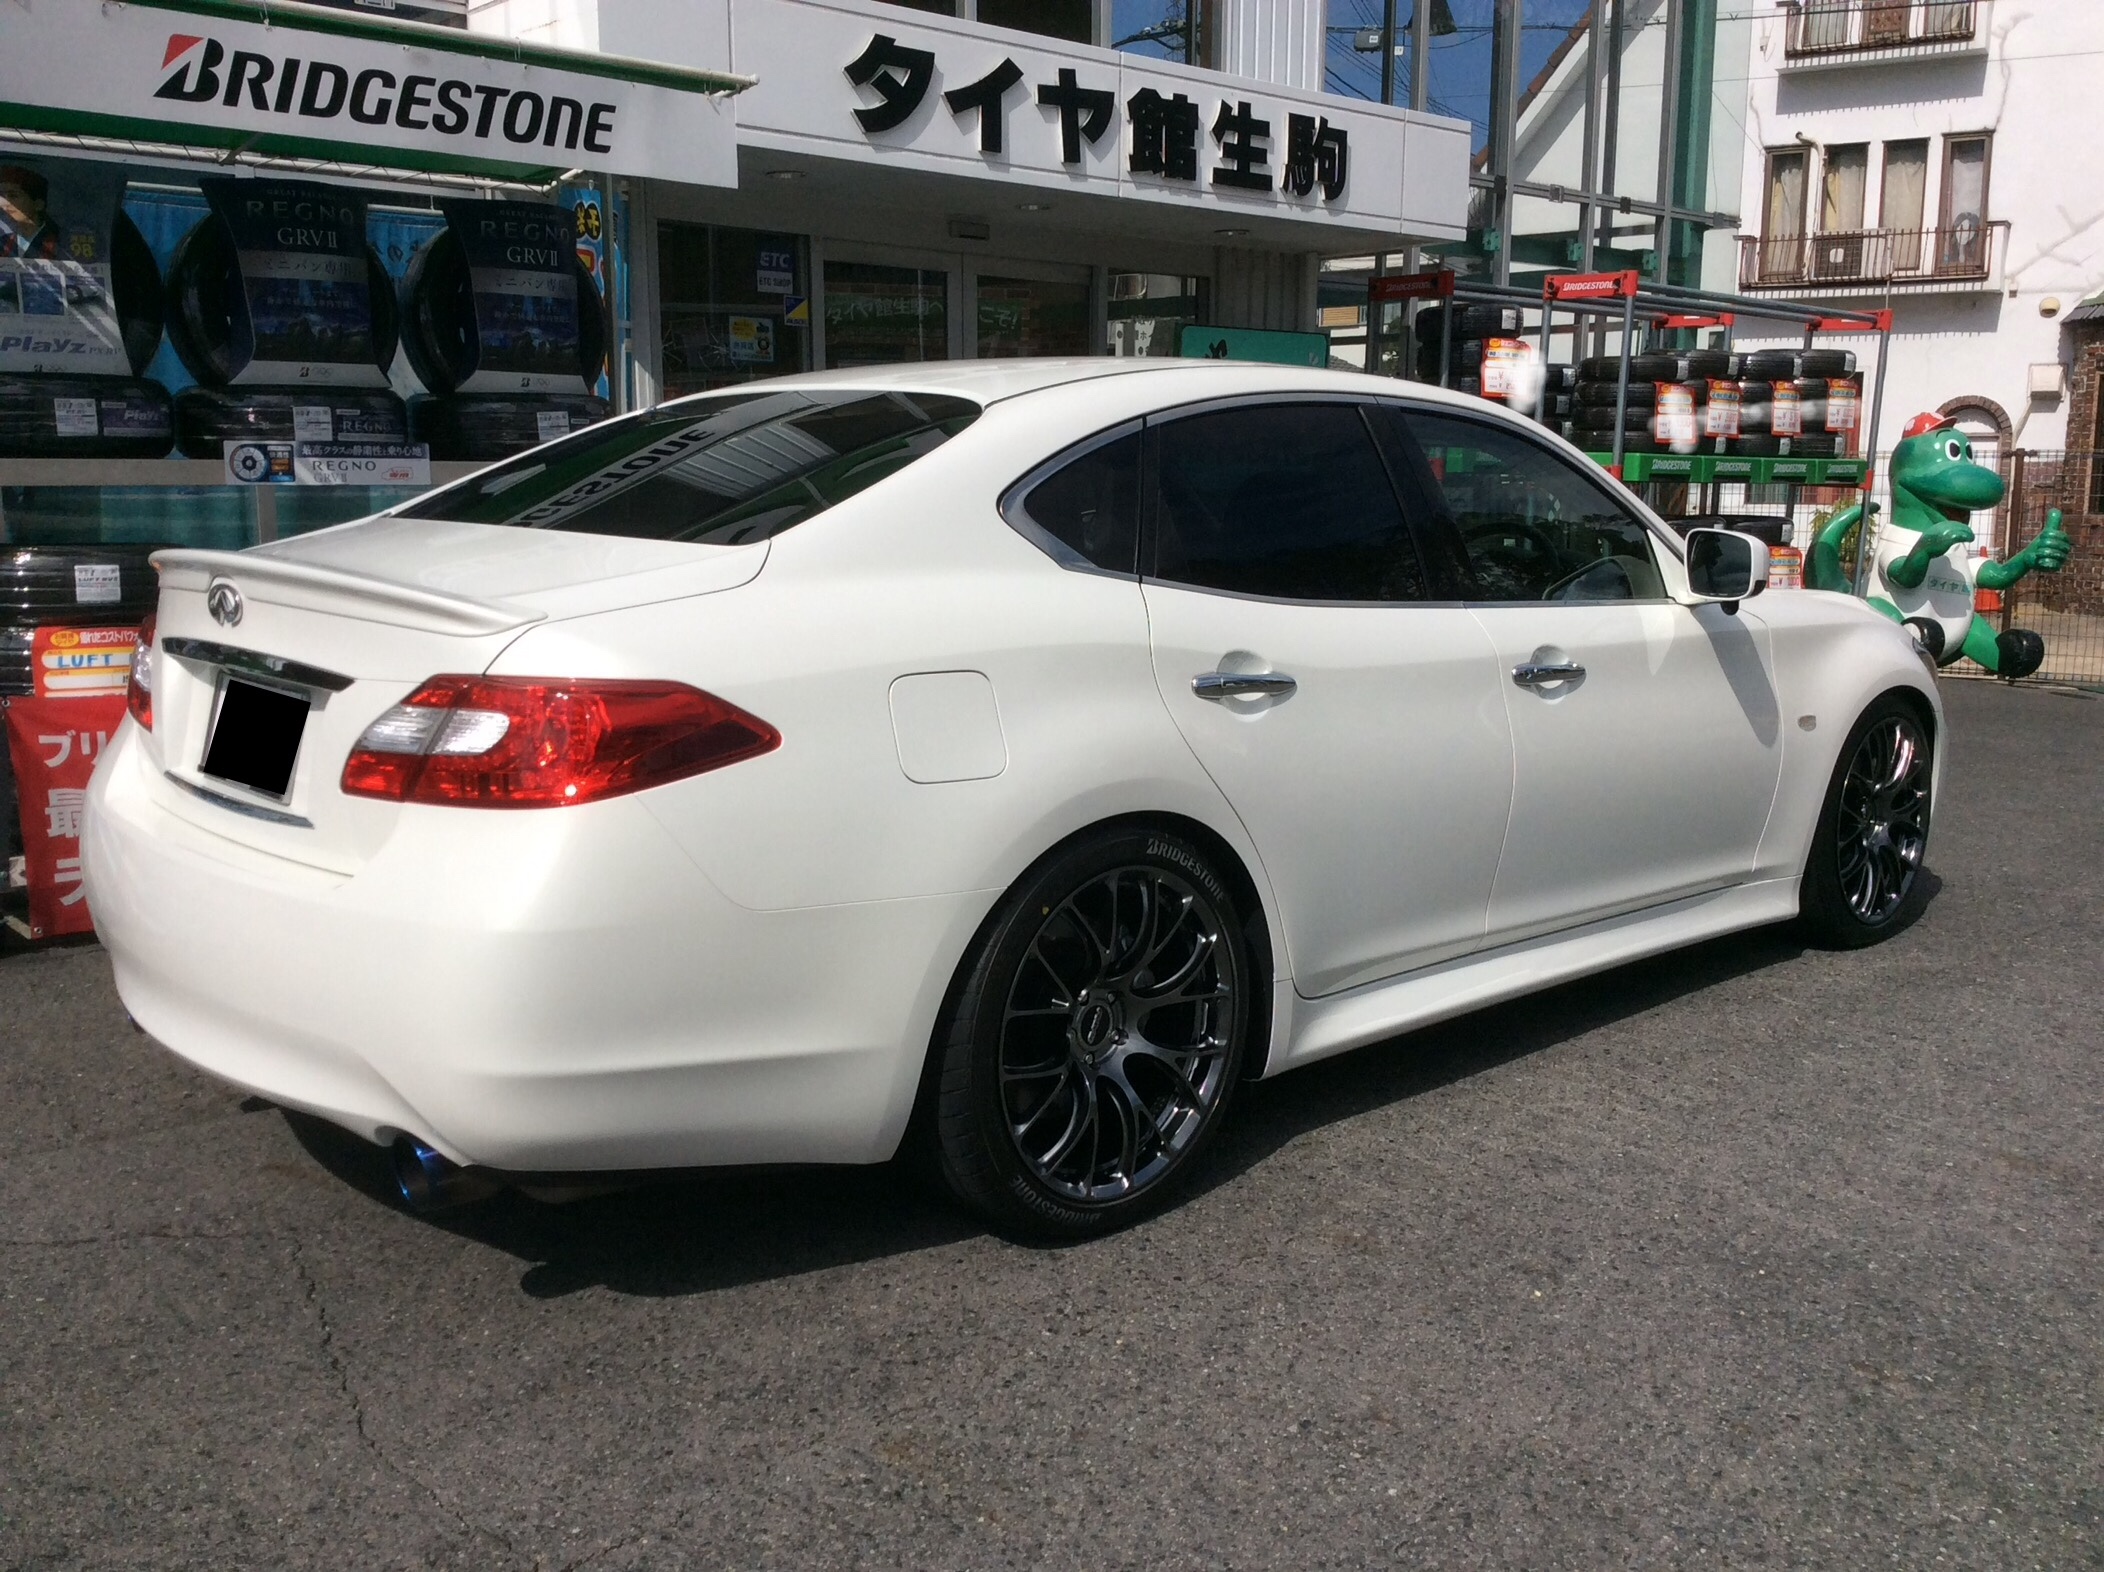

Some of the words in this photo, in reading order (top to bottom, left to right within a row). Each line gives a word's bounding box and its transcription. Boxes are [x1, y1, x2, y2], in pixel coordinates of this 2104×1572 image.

[154, 34, 617, 154] BRIDGESTONE
[842, 33, 1349, 201] タイヤ館生駒
[246, 200, 354, 225] REGNO
[479, 220, 570, 243] REGNO
[759, 251, 791, 268] ETC
[1563, 280, 1614, 292] BRIDGESTONE
[0, 336, 87, 354] Playz
[342, 420, 392, 432] REGNO
[312, 460, 377, 472] REGNO
[1651, 458, 1692, 470] BRIDGESTONE
[1714, 460, 1752, 472] BRIDGESTONE
[57, 653, 113, 668] LUFT
[1146, 838, 1225, 904] BRIDGESTONE
